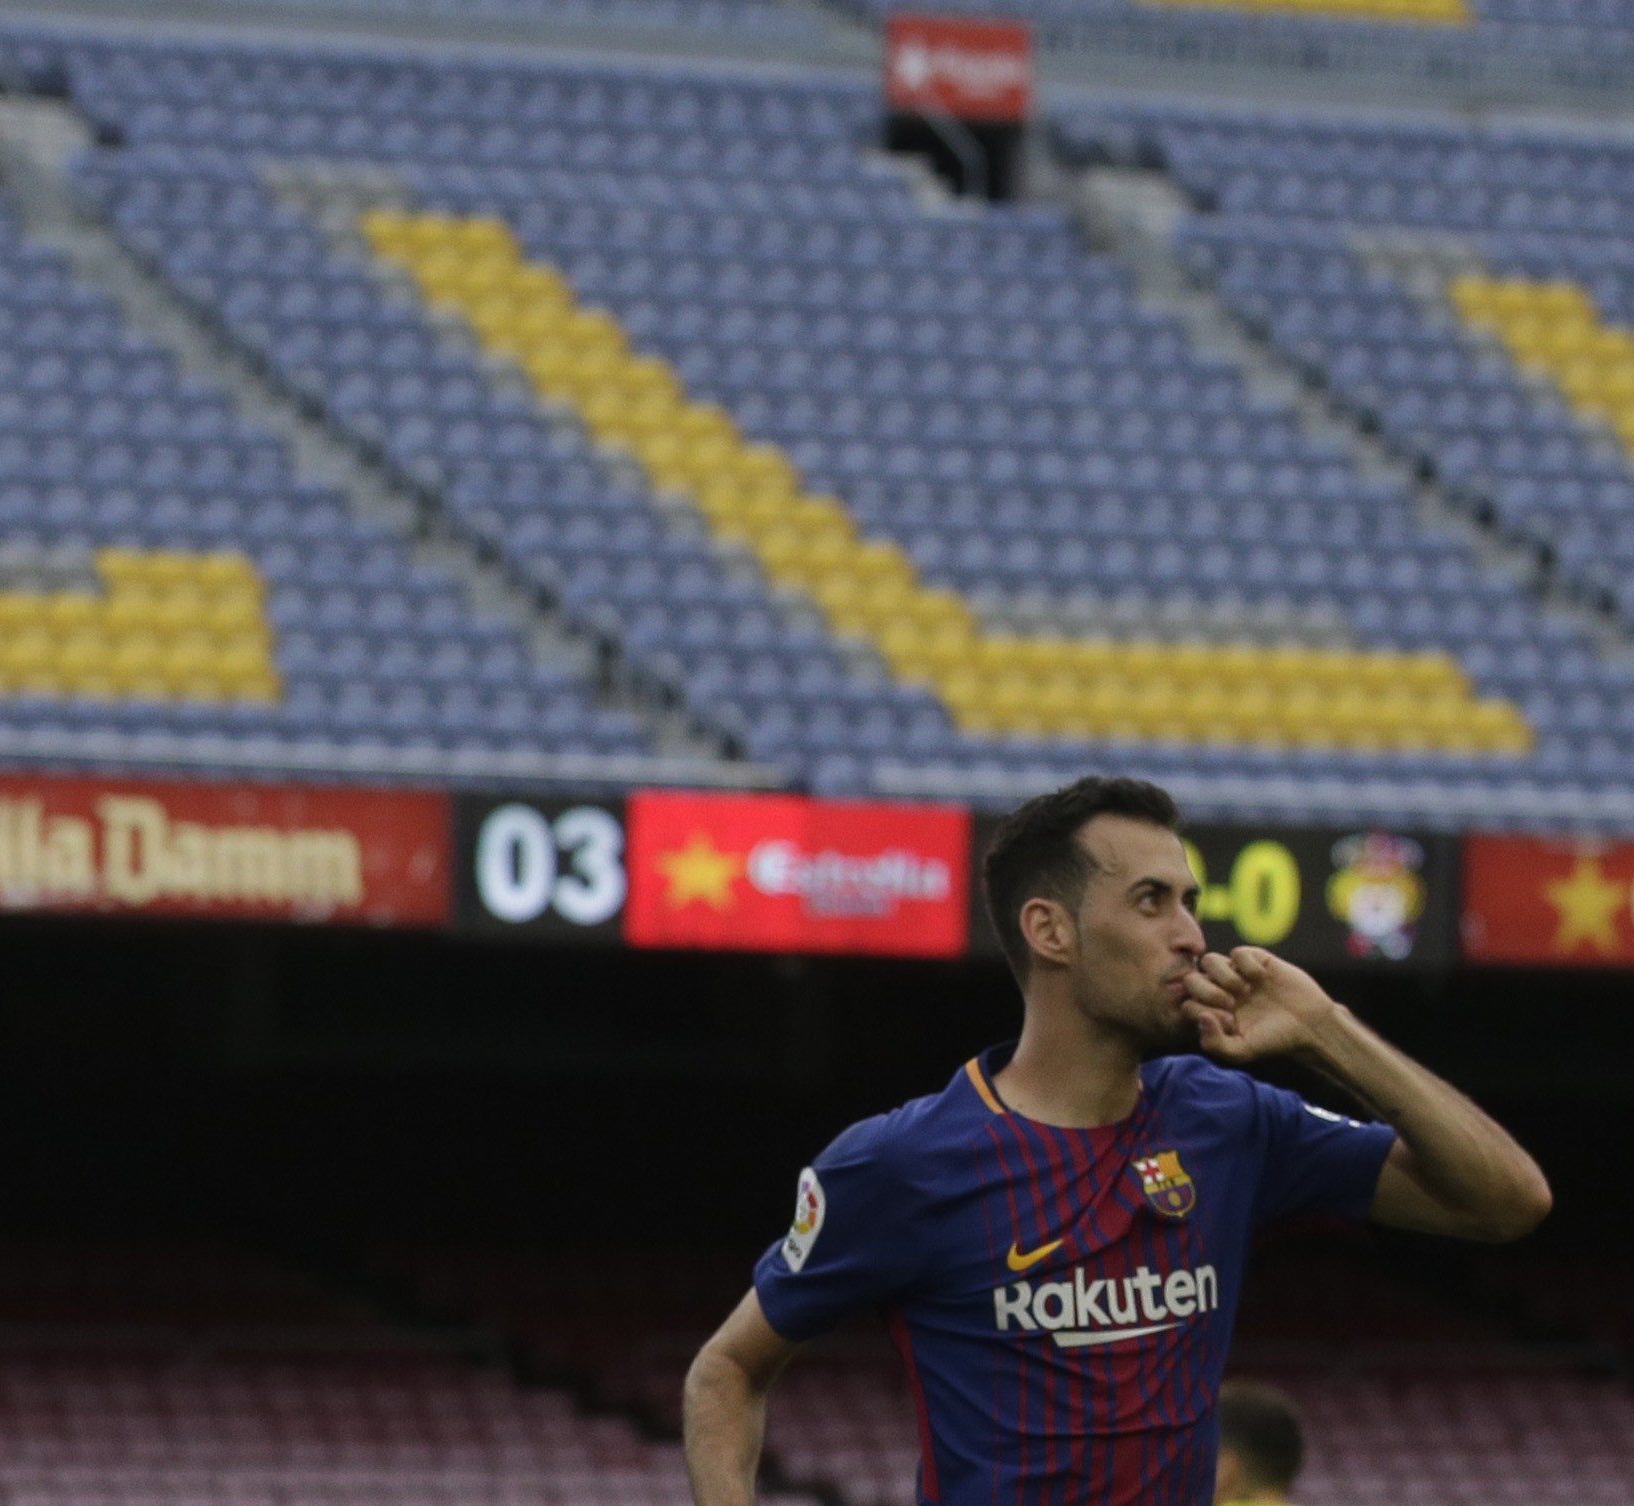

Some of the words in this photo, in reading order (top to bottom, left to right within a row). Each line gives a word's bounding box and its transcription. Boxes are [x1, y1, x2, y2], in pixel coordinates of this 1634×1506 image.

[103, 793, 363, 906] Damm
[474, 802, 628, 928] 03
[1183, 838, 1302, 947] -0
[994, 1263, 1219, 1333] Rakuten
